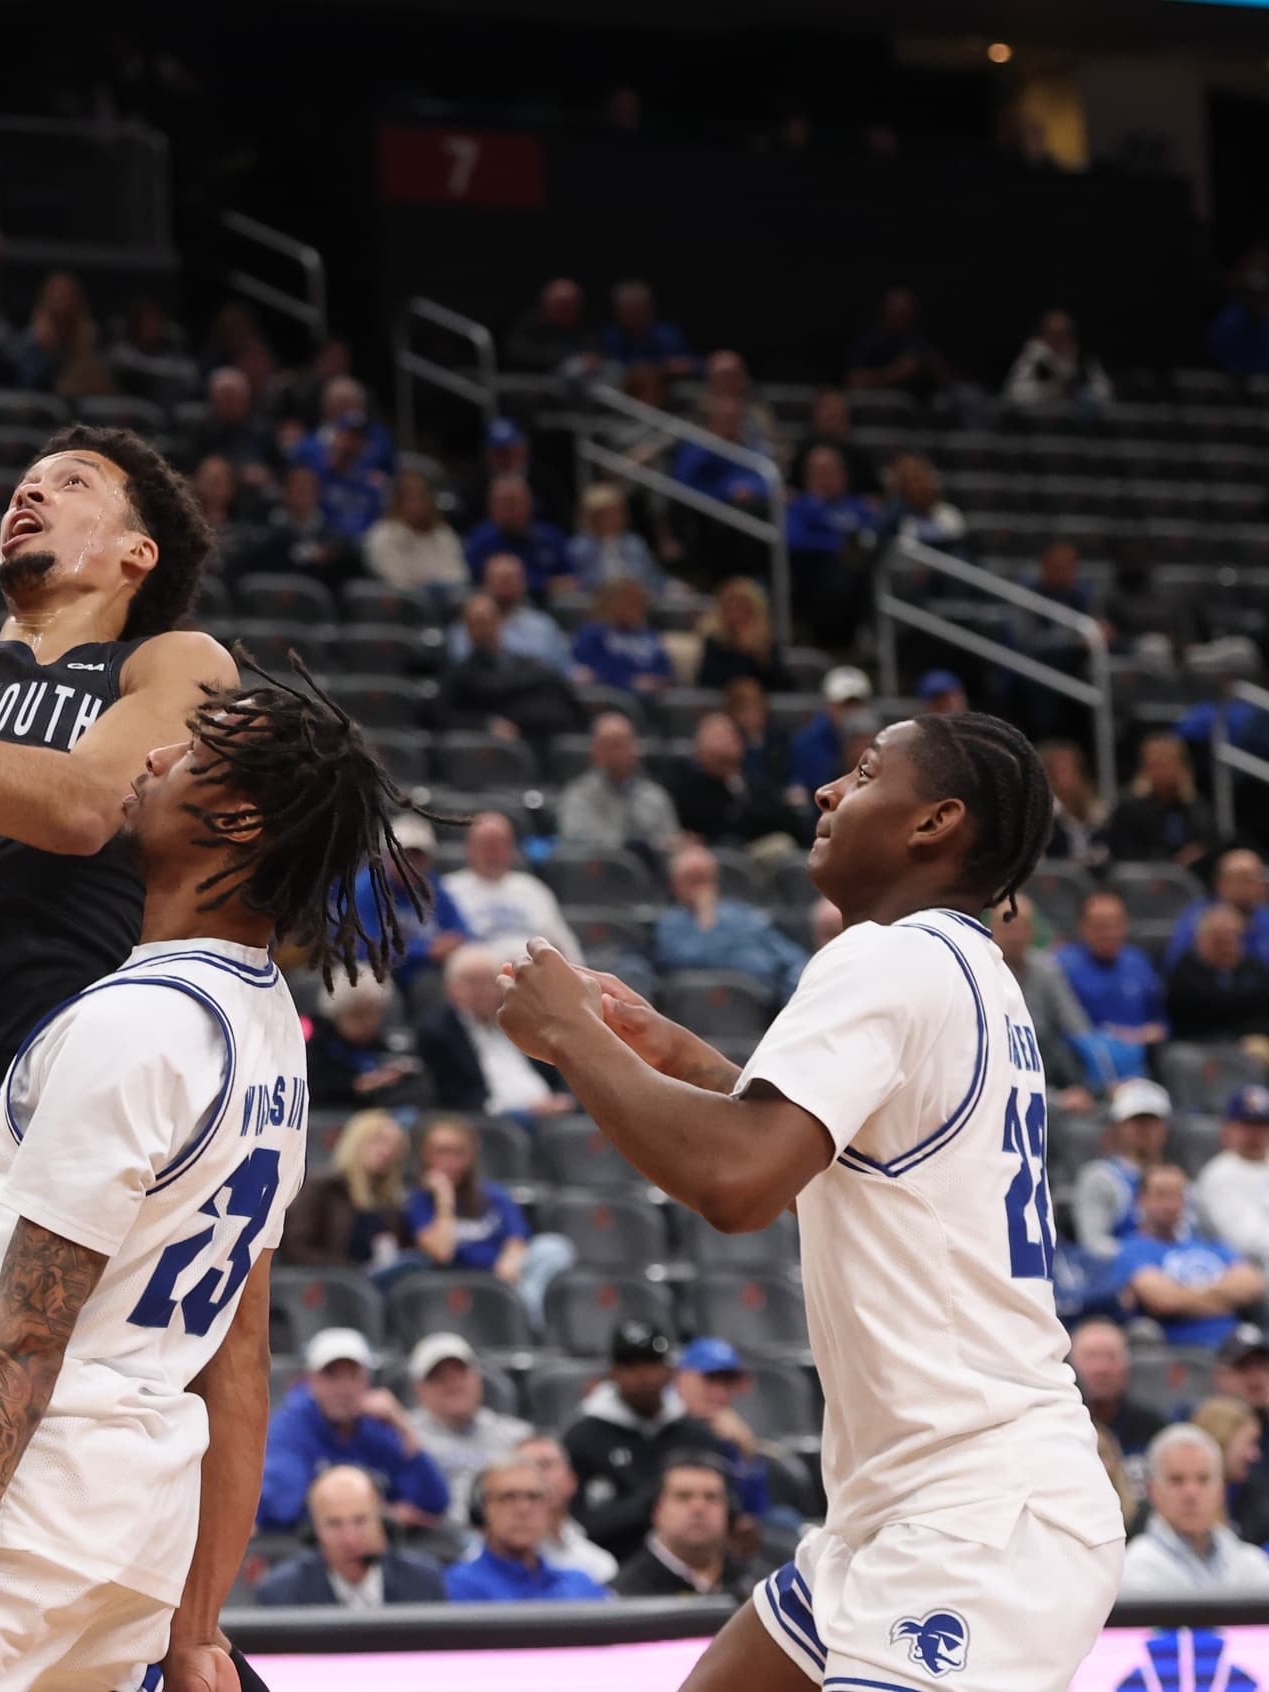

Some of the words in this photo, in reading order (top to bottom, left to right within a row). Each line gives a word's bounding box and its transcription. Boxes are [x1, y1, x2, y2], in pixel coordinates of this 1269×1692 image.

[442, 135, 480, 197] 7
[66, 663, 105, 671] CAA
[126, 1147, 281, 1337] 23
